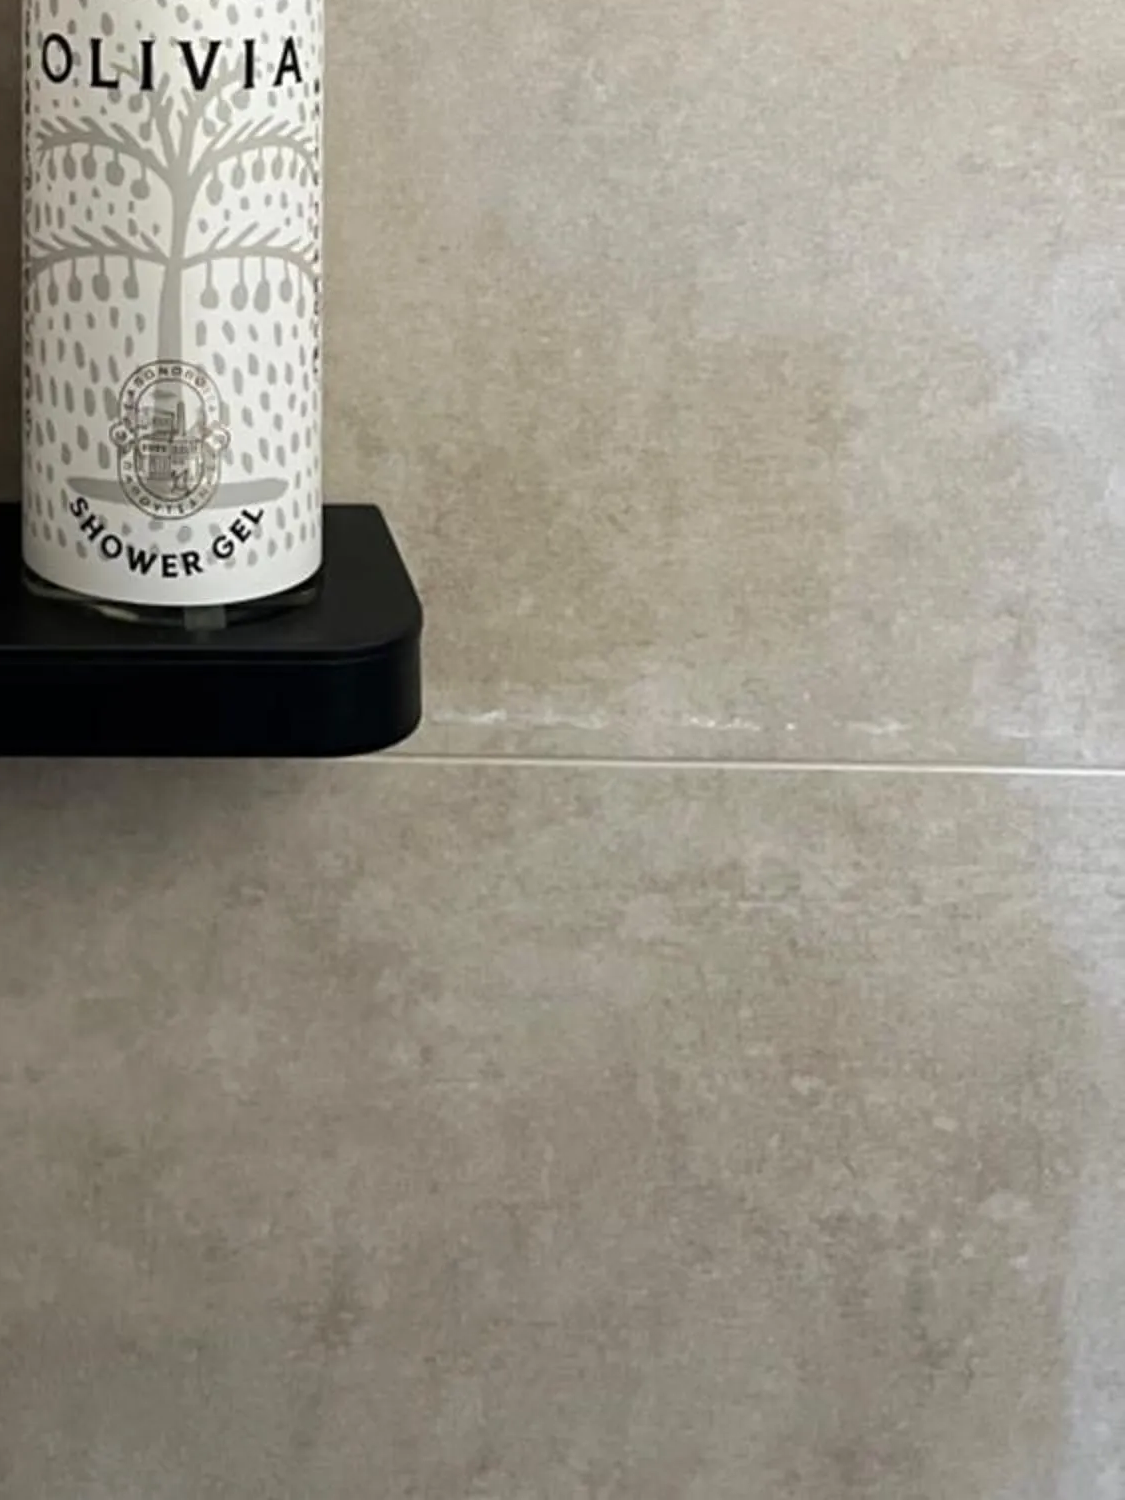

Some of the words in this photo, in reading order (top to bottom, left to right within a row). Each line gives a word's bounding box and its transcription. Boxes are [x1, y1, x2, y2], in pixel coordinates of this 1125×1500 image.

[42, 33, 302, 92] OLIVIA
[69, 497, 203, 578] SHOWER
[212, 506, 264, 559] GEL
